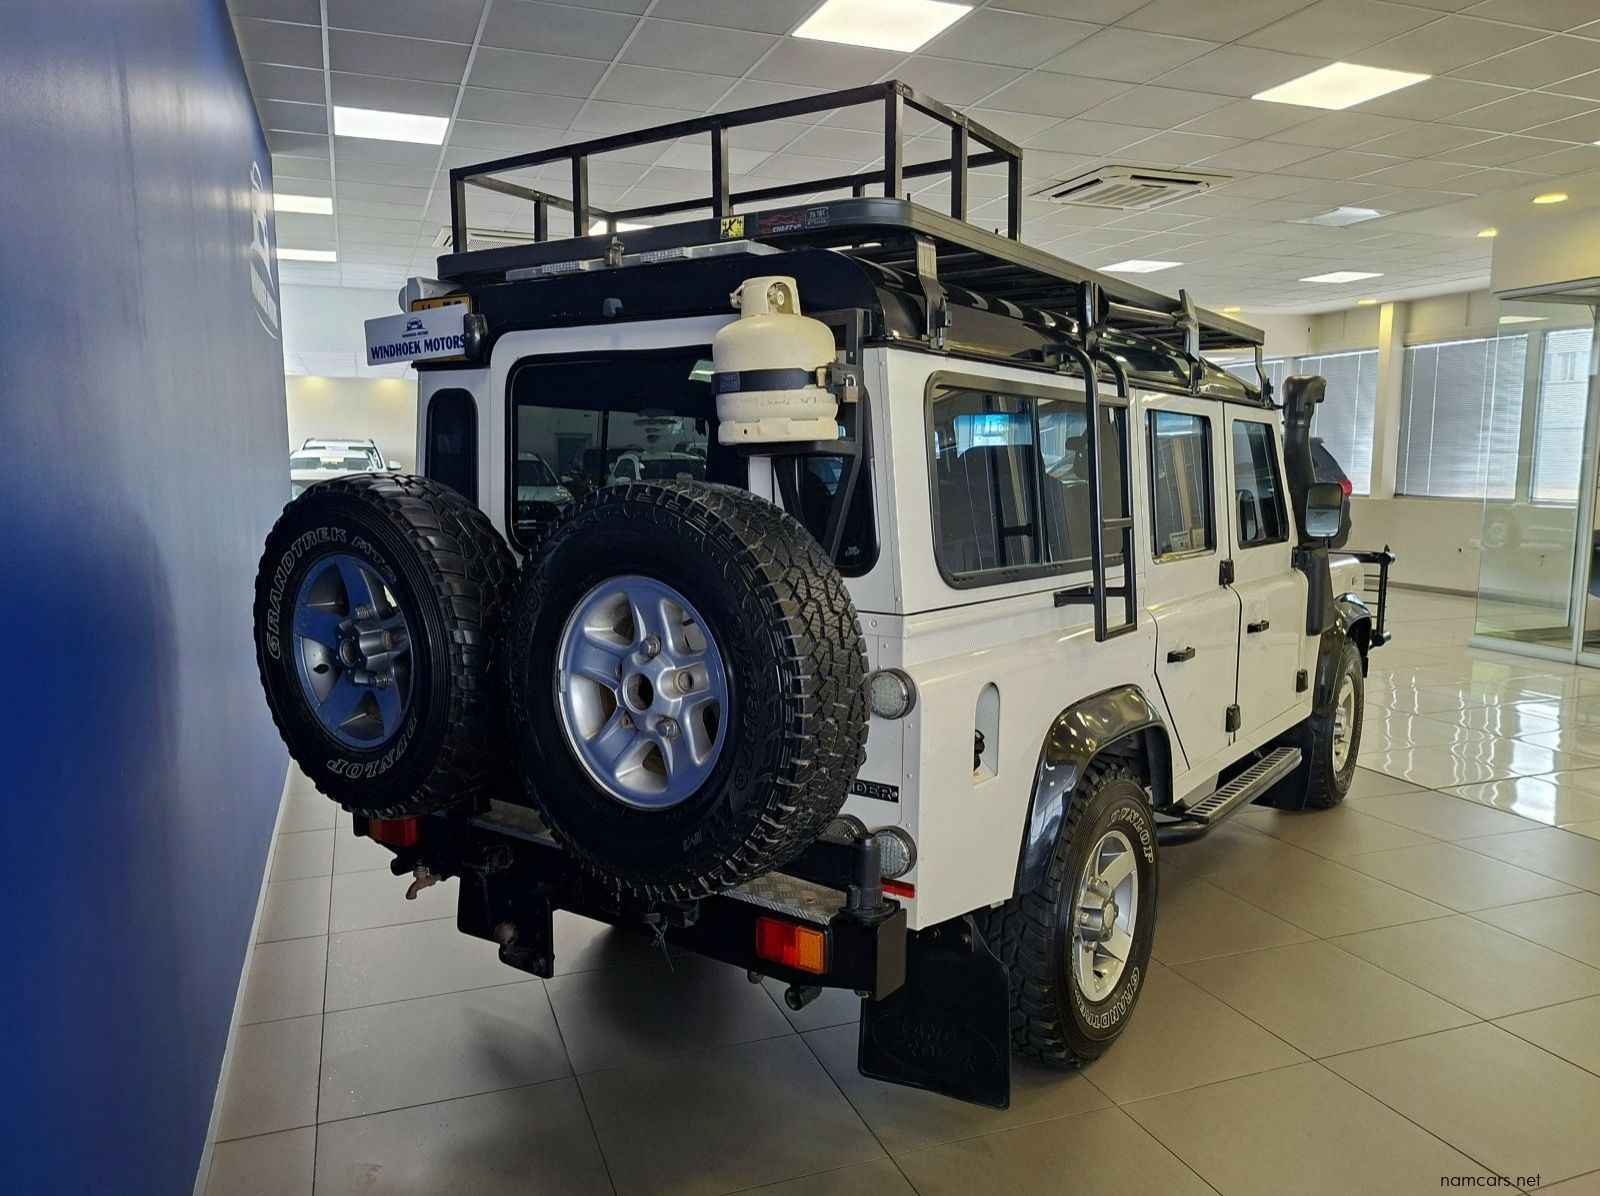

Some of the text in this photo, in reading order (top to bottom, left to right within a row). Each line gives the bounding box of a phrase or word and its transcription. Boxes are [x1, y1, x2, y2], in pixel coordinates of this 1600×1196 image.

[371, 334, 465, 360] WINDHOEK MOTORS
[266, 526, 348, 660] GRANDTREK
[327, 710, 417, 779] DUNLOP
[1106, 807, 1154, 864] DUNLOP
